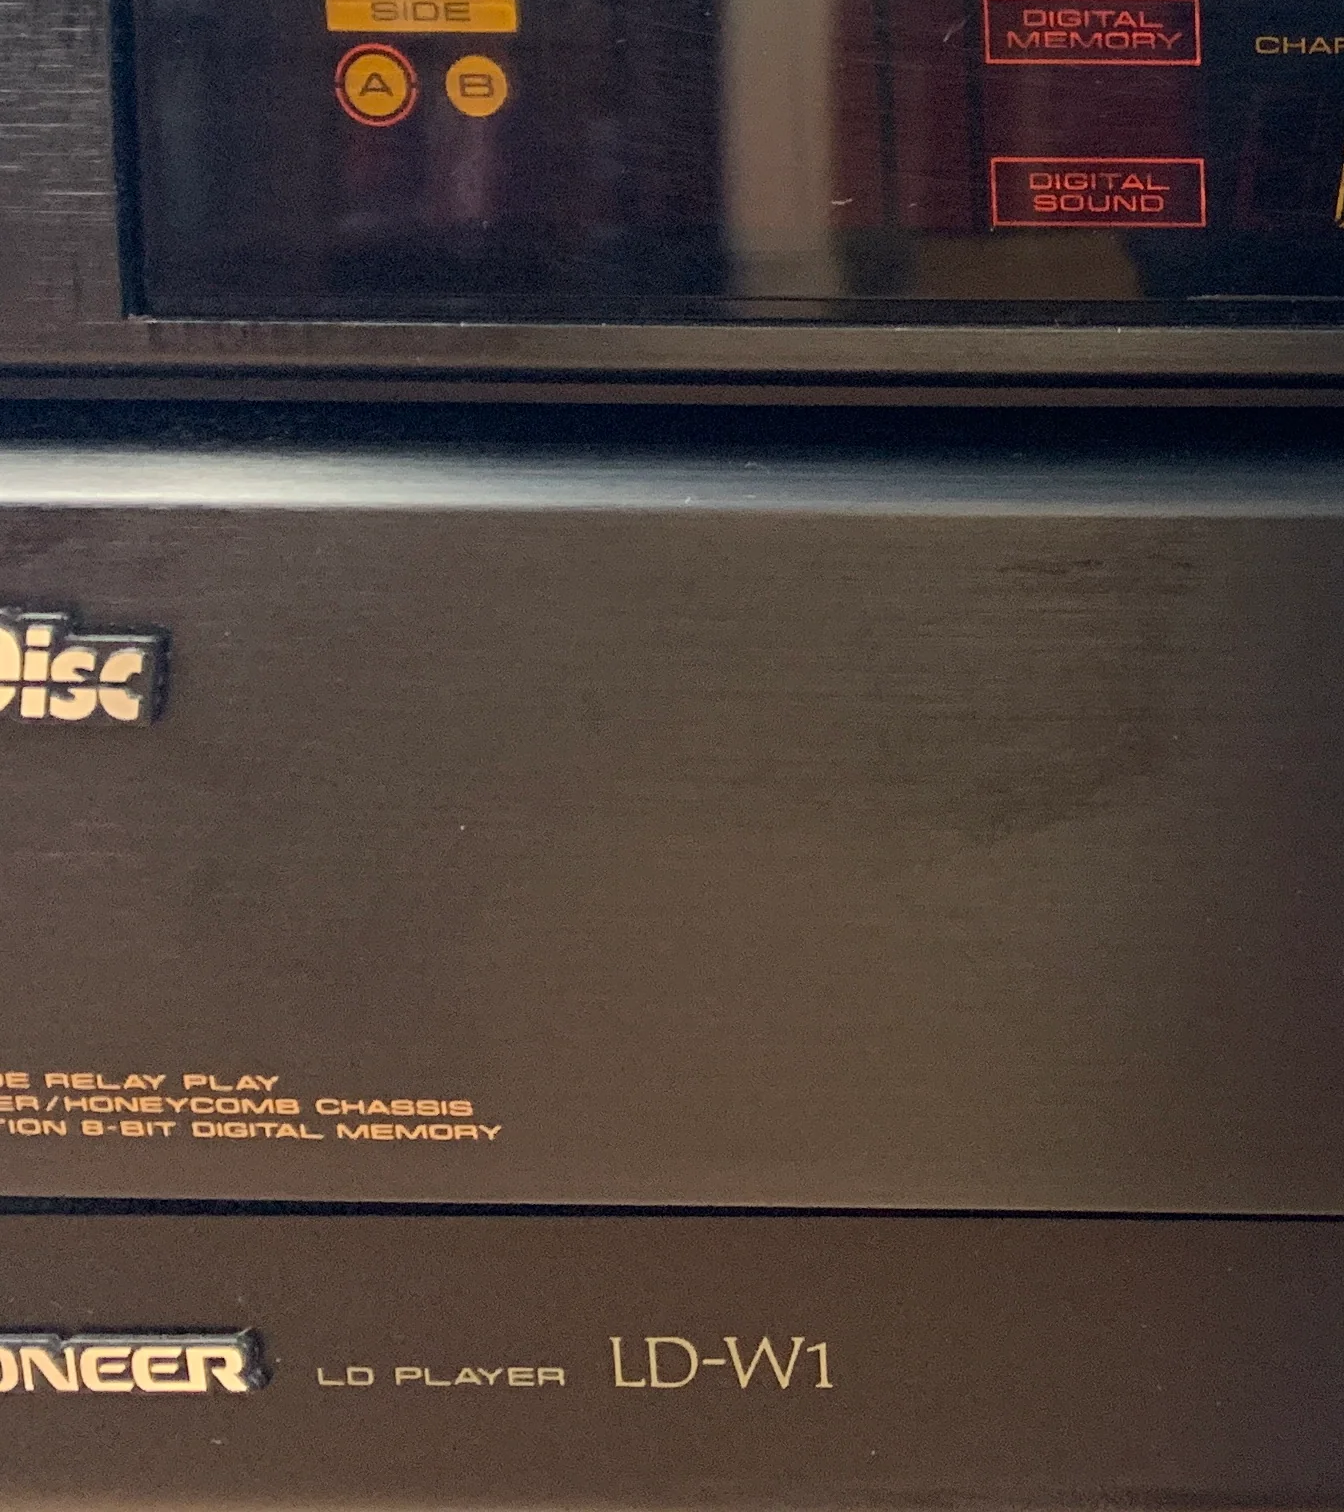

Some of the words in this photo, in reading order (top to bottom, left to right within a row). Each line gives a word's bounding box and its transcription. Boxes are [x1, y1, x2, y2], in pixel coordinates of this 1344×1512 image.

[371, 1, 471, 23] SIDE
[1023, 9, 1163, 28] DIGITAL
[1006, 31, 1183, 50] MEMORY
[1029, 172, 1170, 190] DIGITAL
[1033, 194, 1165, 213] SOUND
[44, 1073, 167, 1090] RELAY
[183, 1074, 279, 1092] PLAY
[315, 1098, 473, 1116] CHASSIS
[81, 1120, 176, 1138] 8-BIT
[192, 1121, 324, 1139] DIGITAL
[336, 1123, 502, 1141] MEMORY
[609, 1336, 834, 1389] LD-W1
[317, 1367, 374, 1387] LD
[395, 1367, 564, 1387] PLAYER
